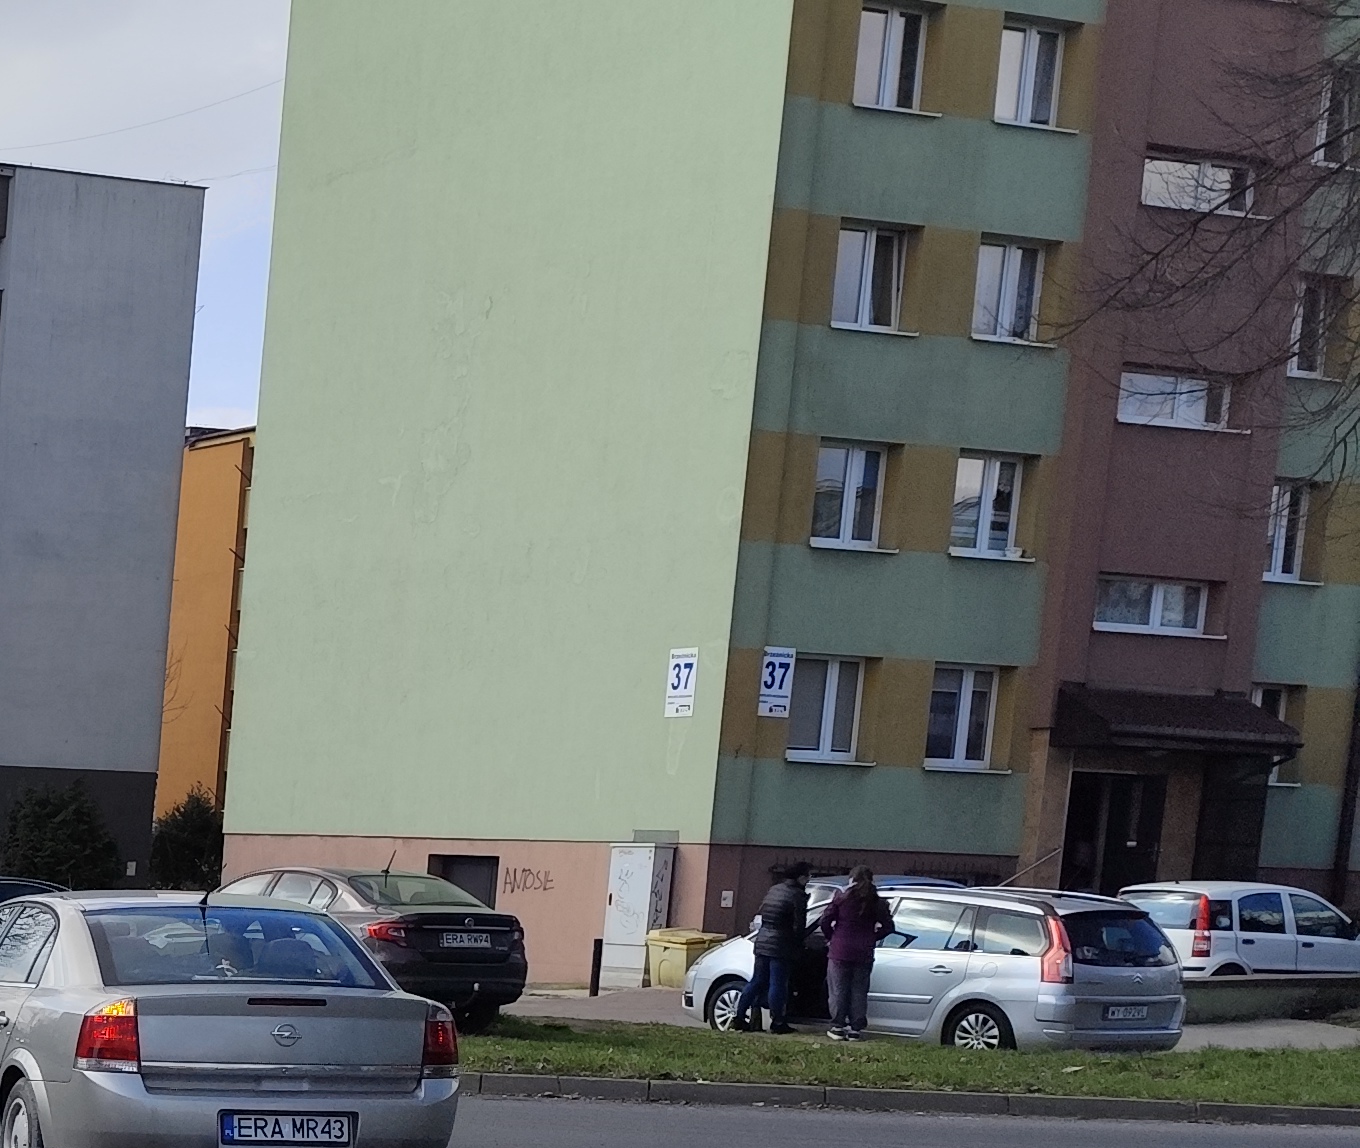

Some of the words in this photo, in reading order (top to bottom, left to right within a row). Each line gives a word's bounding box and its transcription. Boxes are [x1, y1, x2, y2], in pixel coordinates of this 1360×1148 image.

[671, 662, 694, 691] 37
[763, 661, 791, 690] 37
[445, 934, 465, 944] ERA
[237, 1117, 284, 1138] ERA
[292, 1117, 345, 1140] MR43
